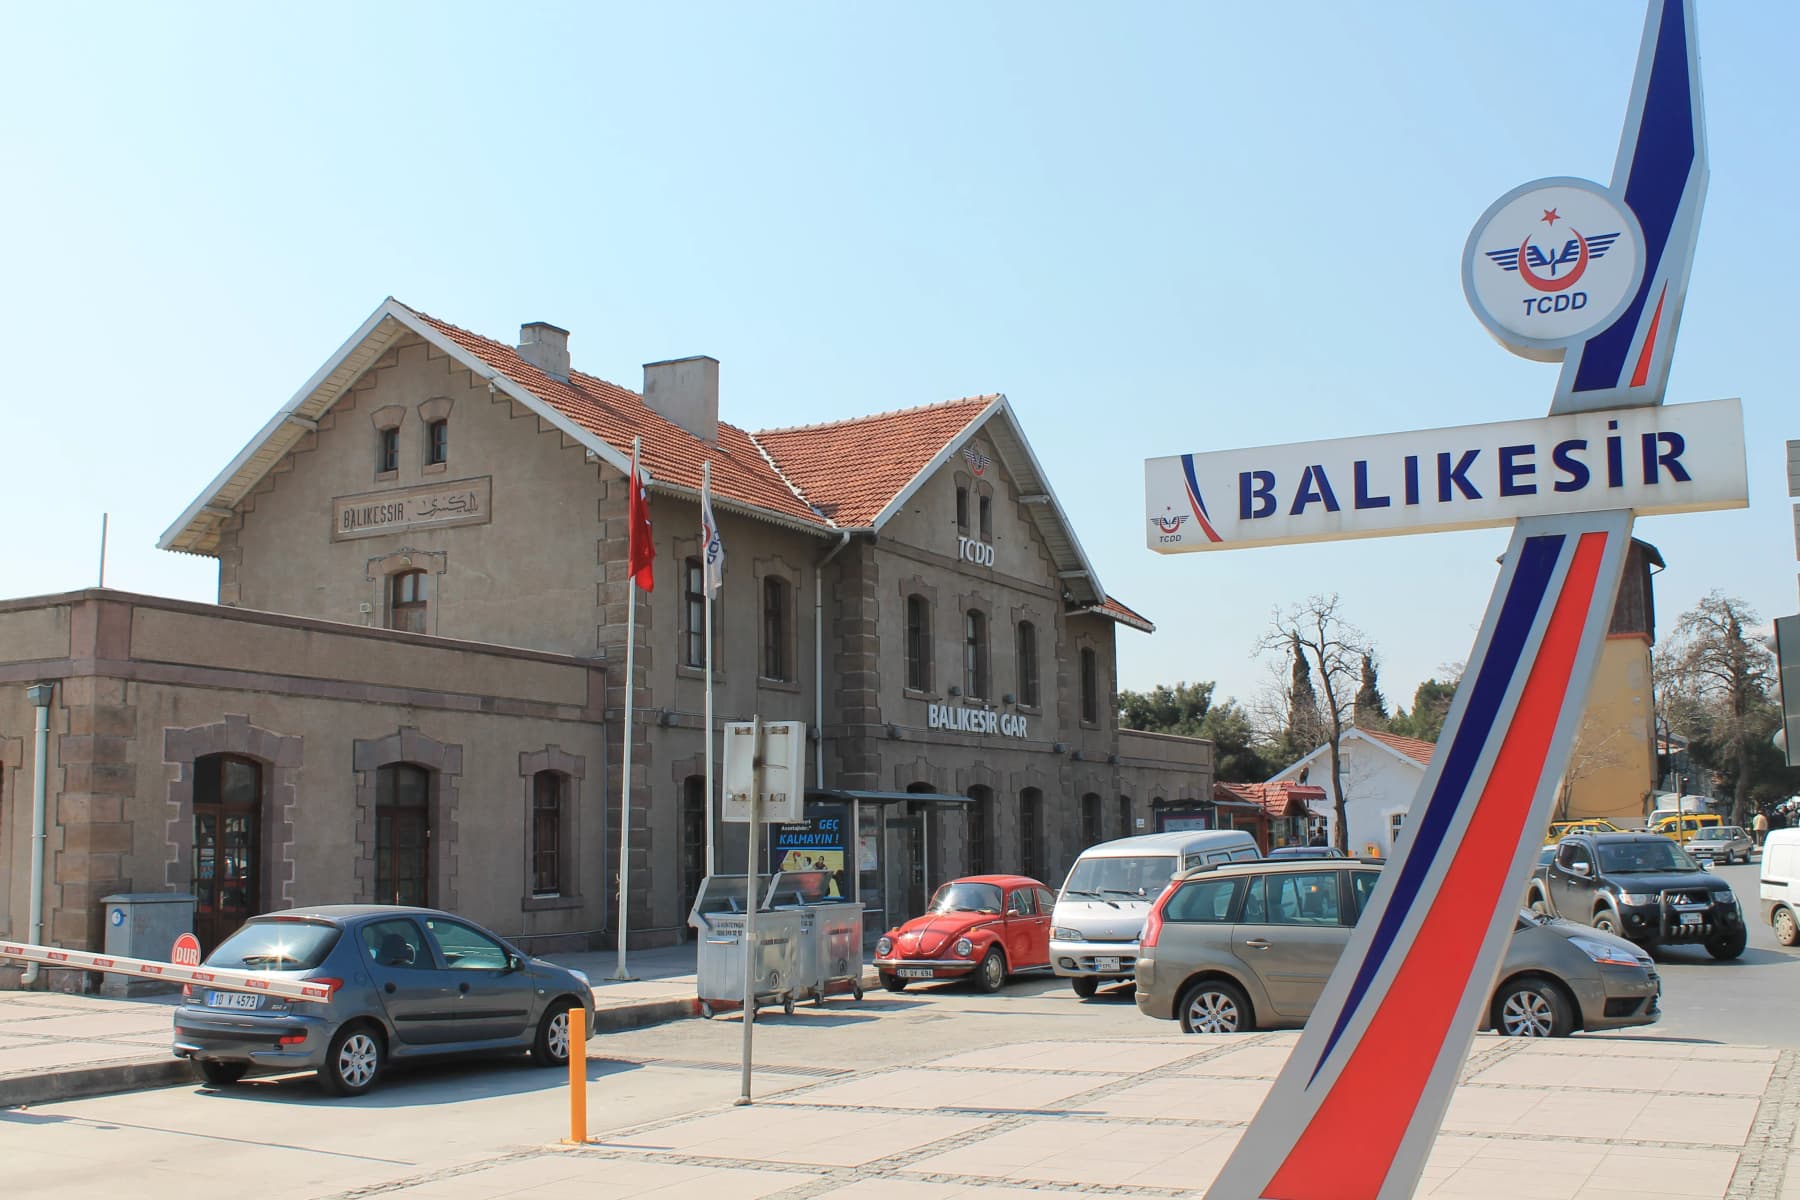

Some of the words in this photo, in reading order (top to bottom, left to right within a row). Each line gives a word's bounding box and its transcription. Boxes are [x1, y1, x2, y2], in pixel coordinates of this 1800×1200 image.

[1523, 292, 1587, 316] TCDD
[1239, 420, 1691, 520] BALIKESİR
[343, 503, 404, 529] BALIKESSIR
[1159, 534, 1182, 543] TCDD
[958, 536, 995, 567] TCDD
[928, 702, 998, 733] BALIKESİR
[1000, 714, 1028, 738] GAR
[819, 818, 840, 831] GEÇ
[779, 833, 832, 845] KALMAYIN
[175, 946, 198, 965] DUR
[236, 994, 256, 1008] 4573
